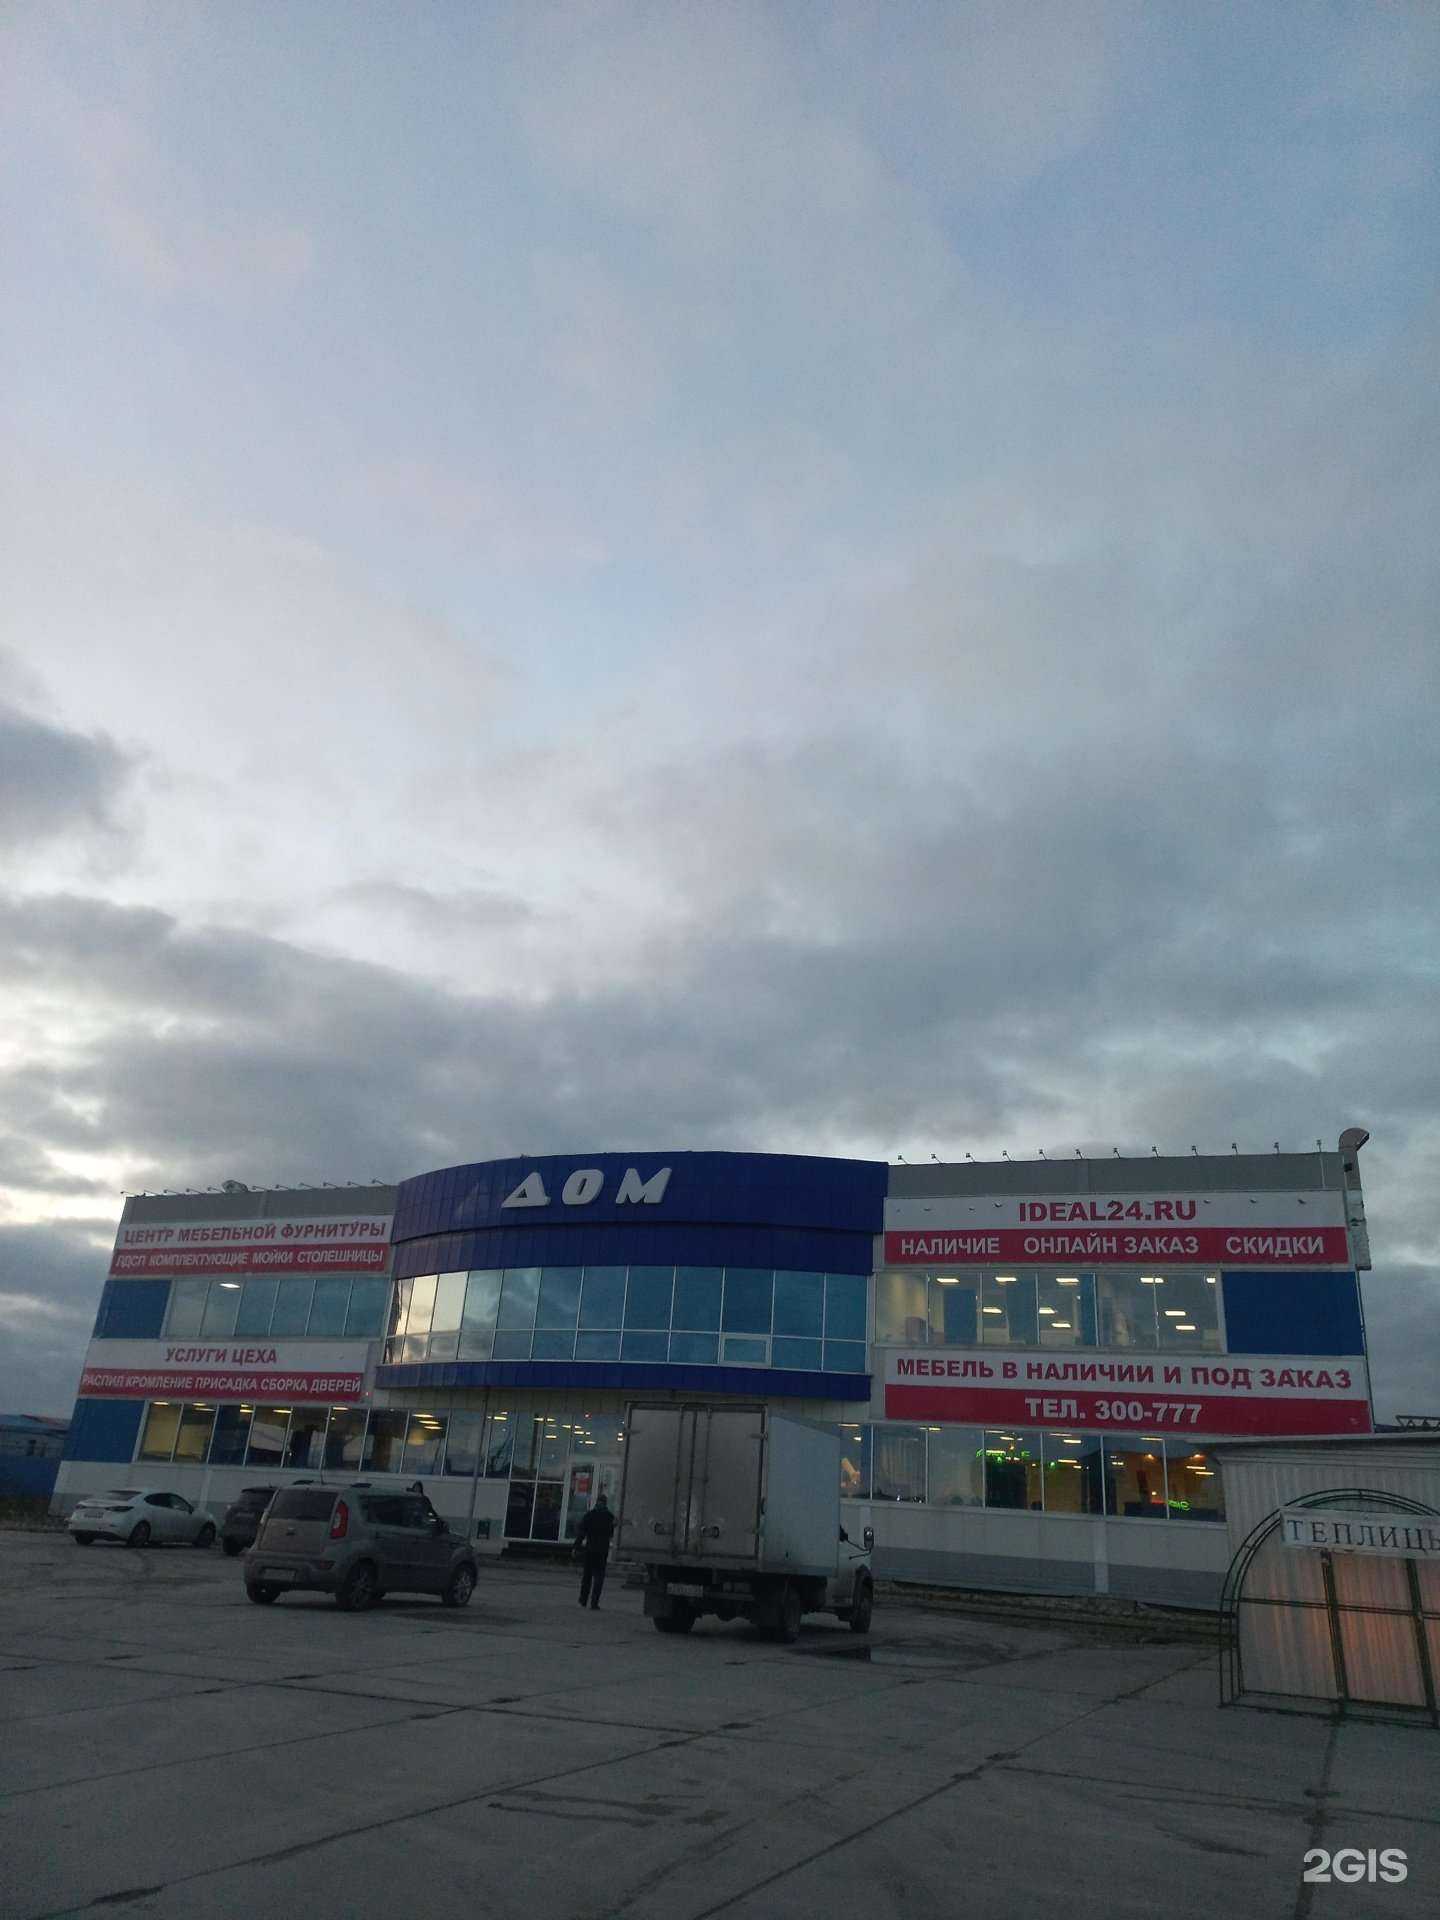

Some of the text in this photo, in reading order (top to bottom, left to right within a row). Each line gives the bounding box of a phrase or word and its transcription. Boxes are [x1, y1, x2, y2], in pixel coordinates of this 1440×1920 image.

[501, 1167, 672, 1208] ДОМ
[1019, 1200, 1196, 1222] IDEAL24.RU
[124, 1221, 386, 1245] ЦЕНТР МЕБЕЛЬНОЙ ФУРНИТУРЫ
[901, 1232, 1324, 1258] НАЛИЧИЕ ОНЛАЙН ЗАКАЗ СКИДКИ
[115, 1248, 383, 1269] ЛДСП КОМПЛЕКТУЮЩИЕ МОЙКИ СТОЛЕШНИЦЫ
[165, 1348, 277, 1366] УСЛУГИ ЦЕХА
[81, 1374, 360, 1393] РАСПИЛ КРОМЛЕНИЕ ПРИСАДКА СБОРКА ДВЕРЕЙ
[897, 1358, 1352, 1390] МЕБЕЛЬ В НАЛИЧИИ И ПОД ЗАКАЗ
[1025, 1398, 1202, 1424] ТЕЛ. 300-777
